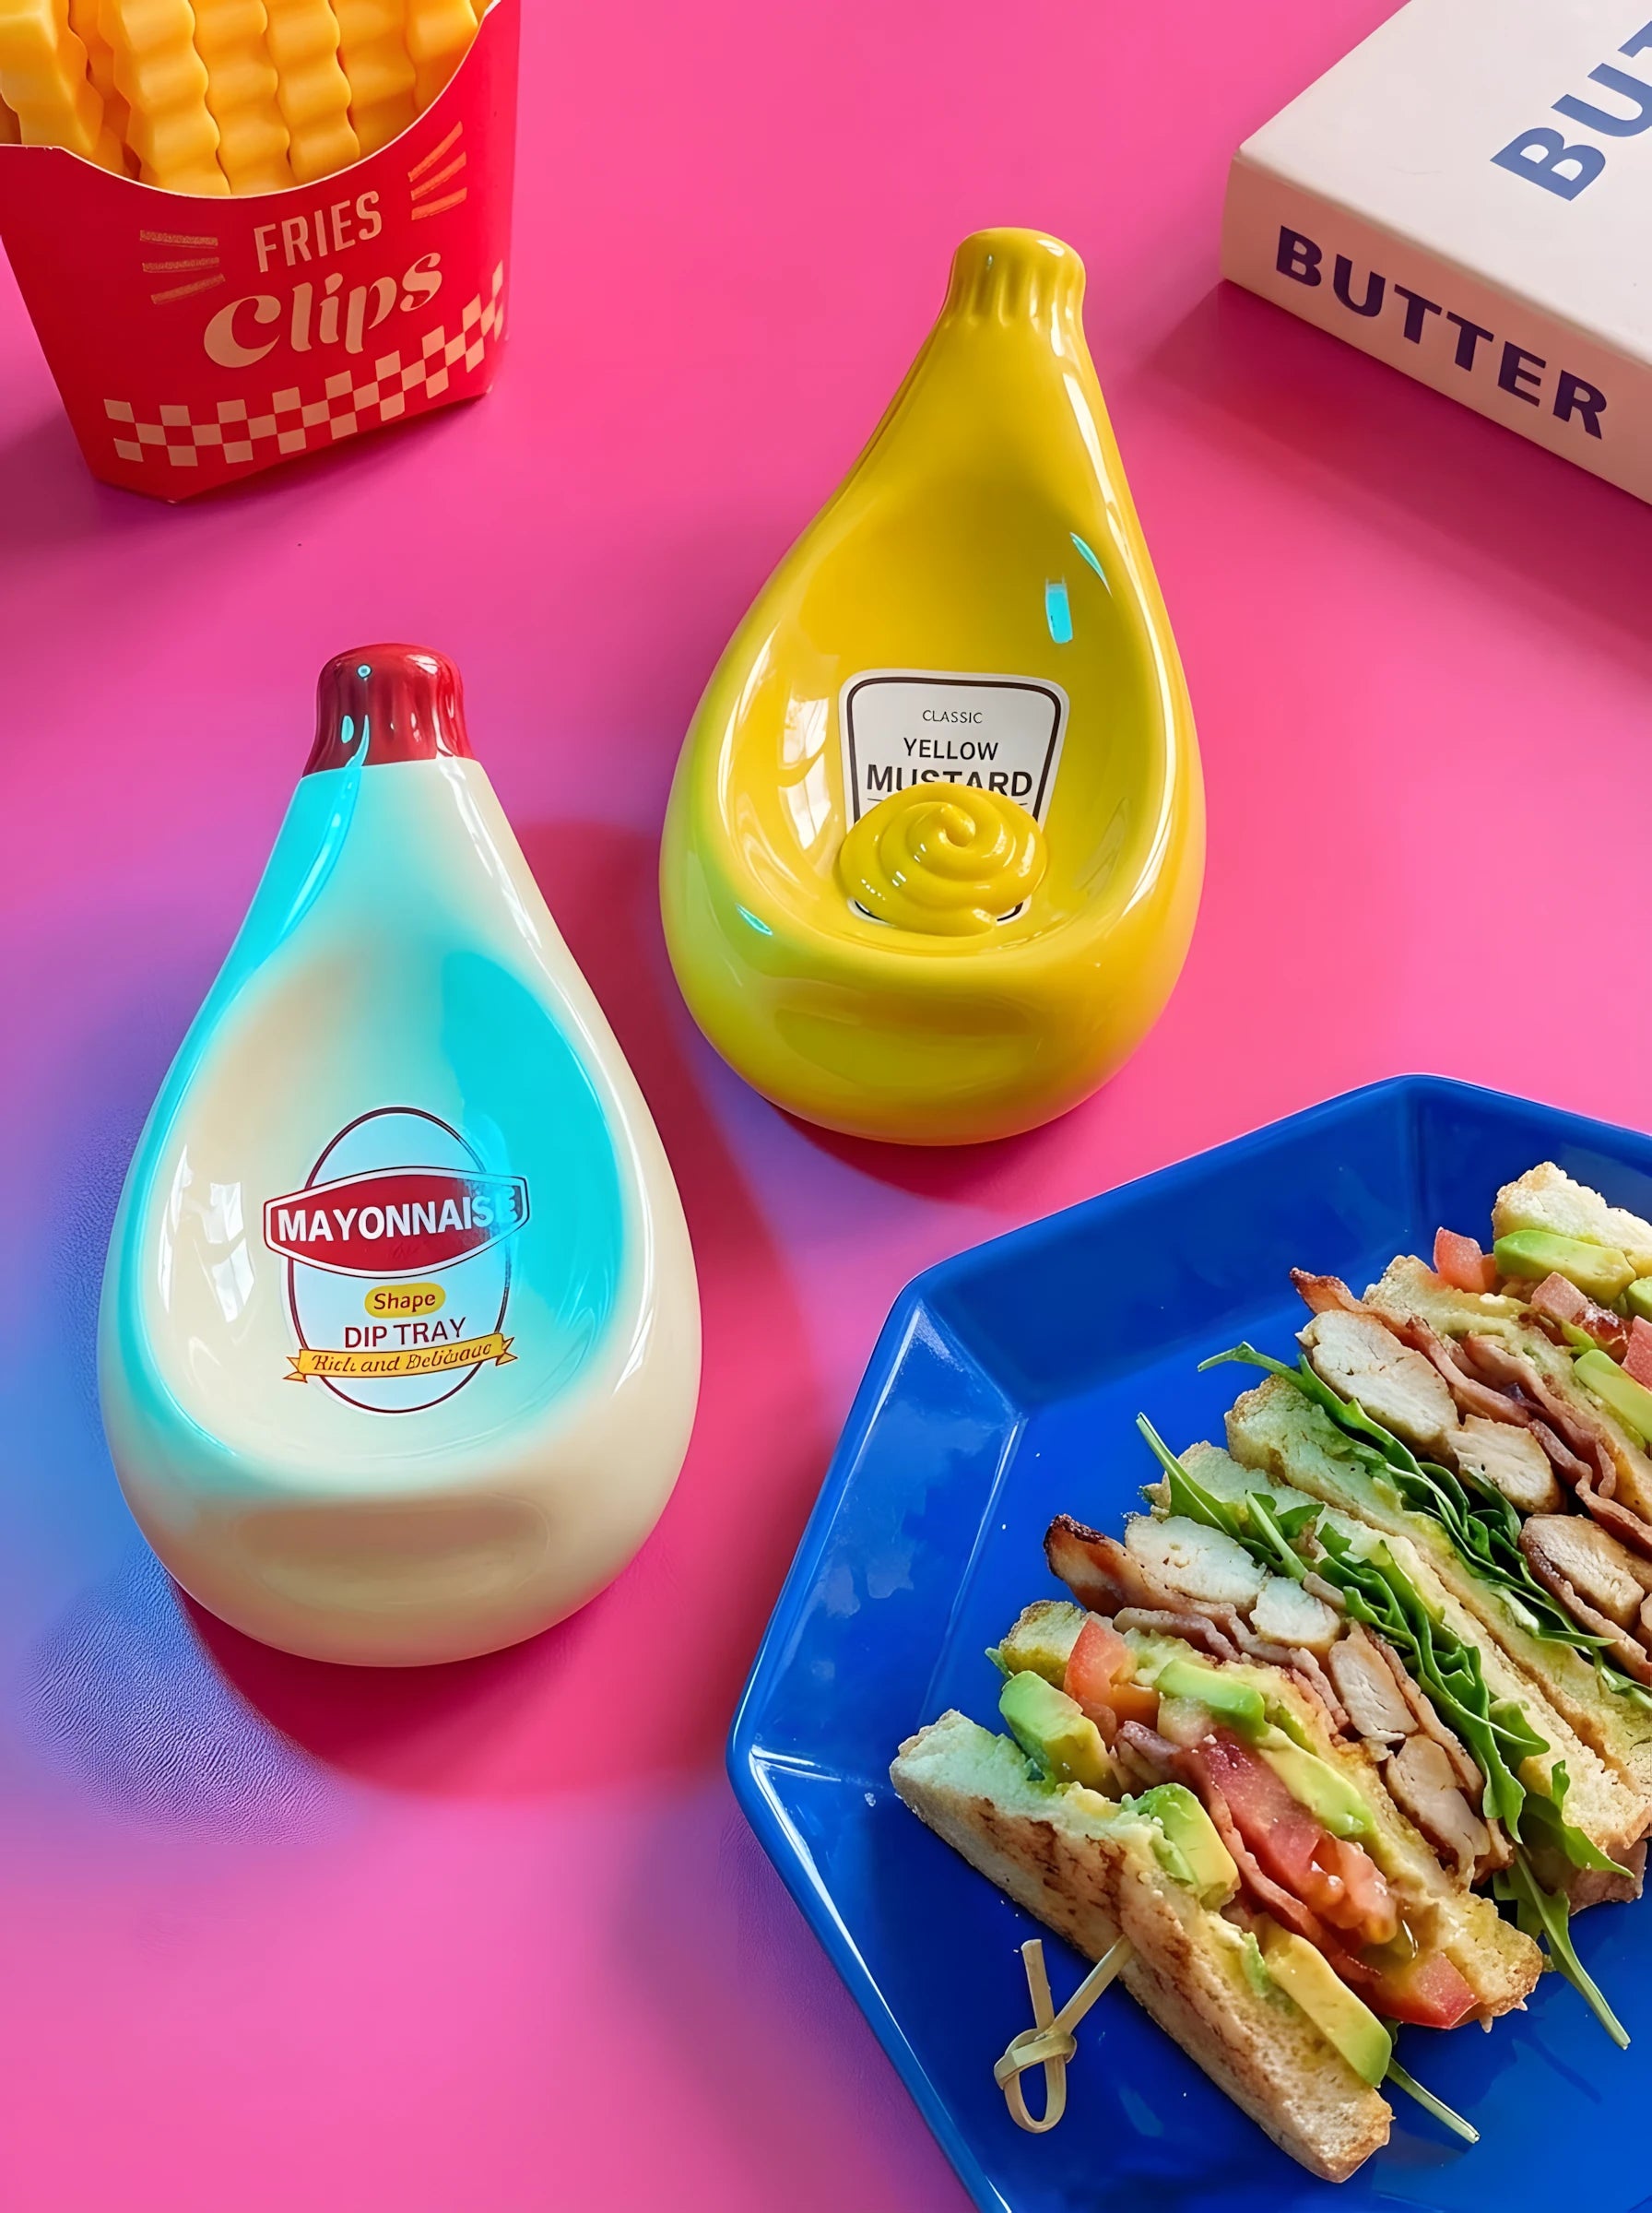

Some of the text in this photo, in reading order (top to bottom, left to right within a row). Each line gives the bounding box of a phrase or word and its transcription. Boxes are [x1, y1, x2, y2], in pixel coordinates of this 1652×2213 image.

[254, 190, 383, 273] FRIES
[203, 252, 442, 369] Clips
[1275, 224, 1608, 441] BUTTER
[922, 709, 984, 724] CLASSIC
[903, 737, 998, 761] YELLOW
[373, 1292, 436, 1313] Shape
[344, 1316, 466, 1348] DIP TRAY
[360, 1355, 401, 1372] and
